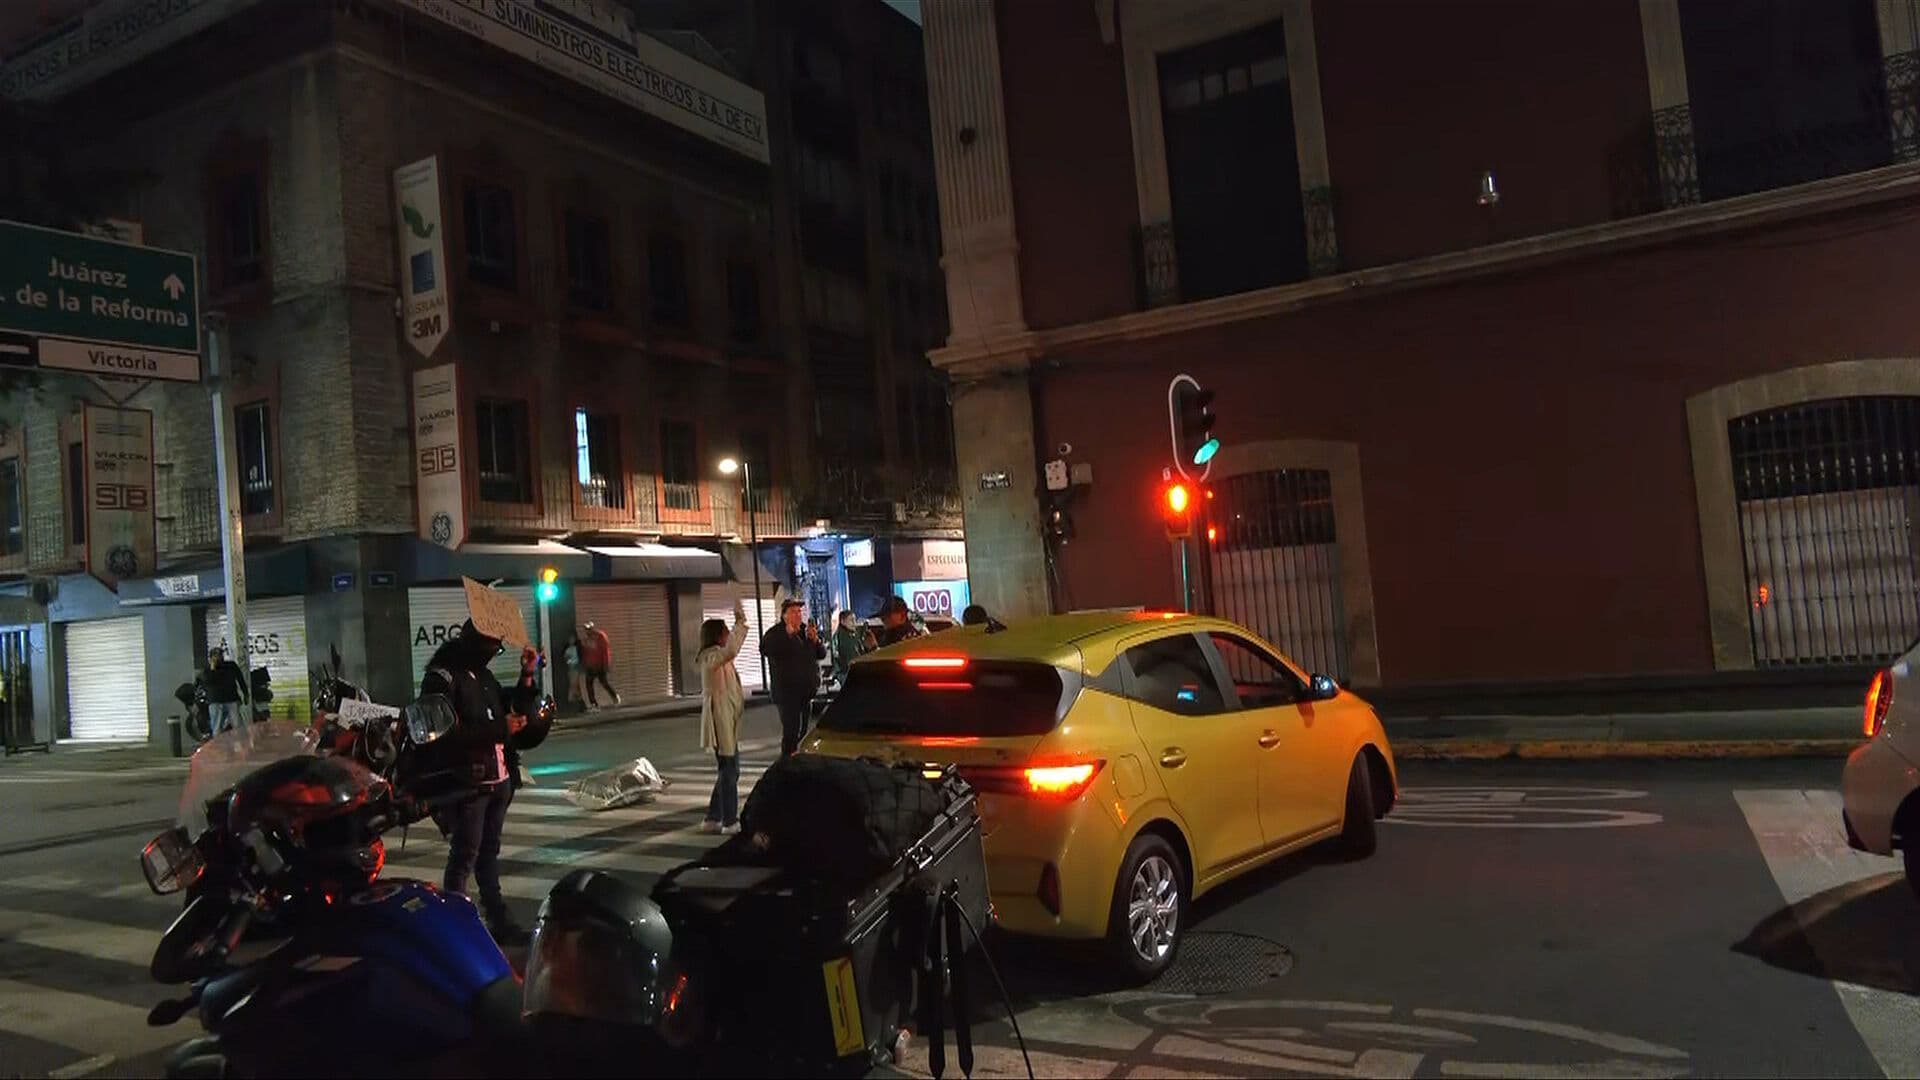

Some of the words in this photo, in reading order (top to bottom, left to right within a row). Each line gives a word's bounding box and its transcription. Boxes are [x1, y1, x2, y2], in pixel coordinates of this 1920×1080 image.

[495, 0, 603, 66] SUMINISTROS
[725, 111, 744, 131] DE
[48, 256, 128, 289] Juárez
[15, 282, 48, 308] de
[58, 287, 81, 313] la
[90, 294, 189, 327] Reforma
[412, 314, 442, 339] 3M
[87, 349, 157, 371] Victoria
